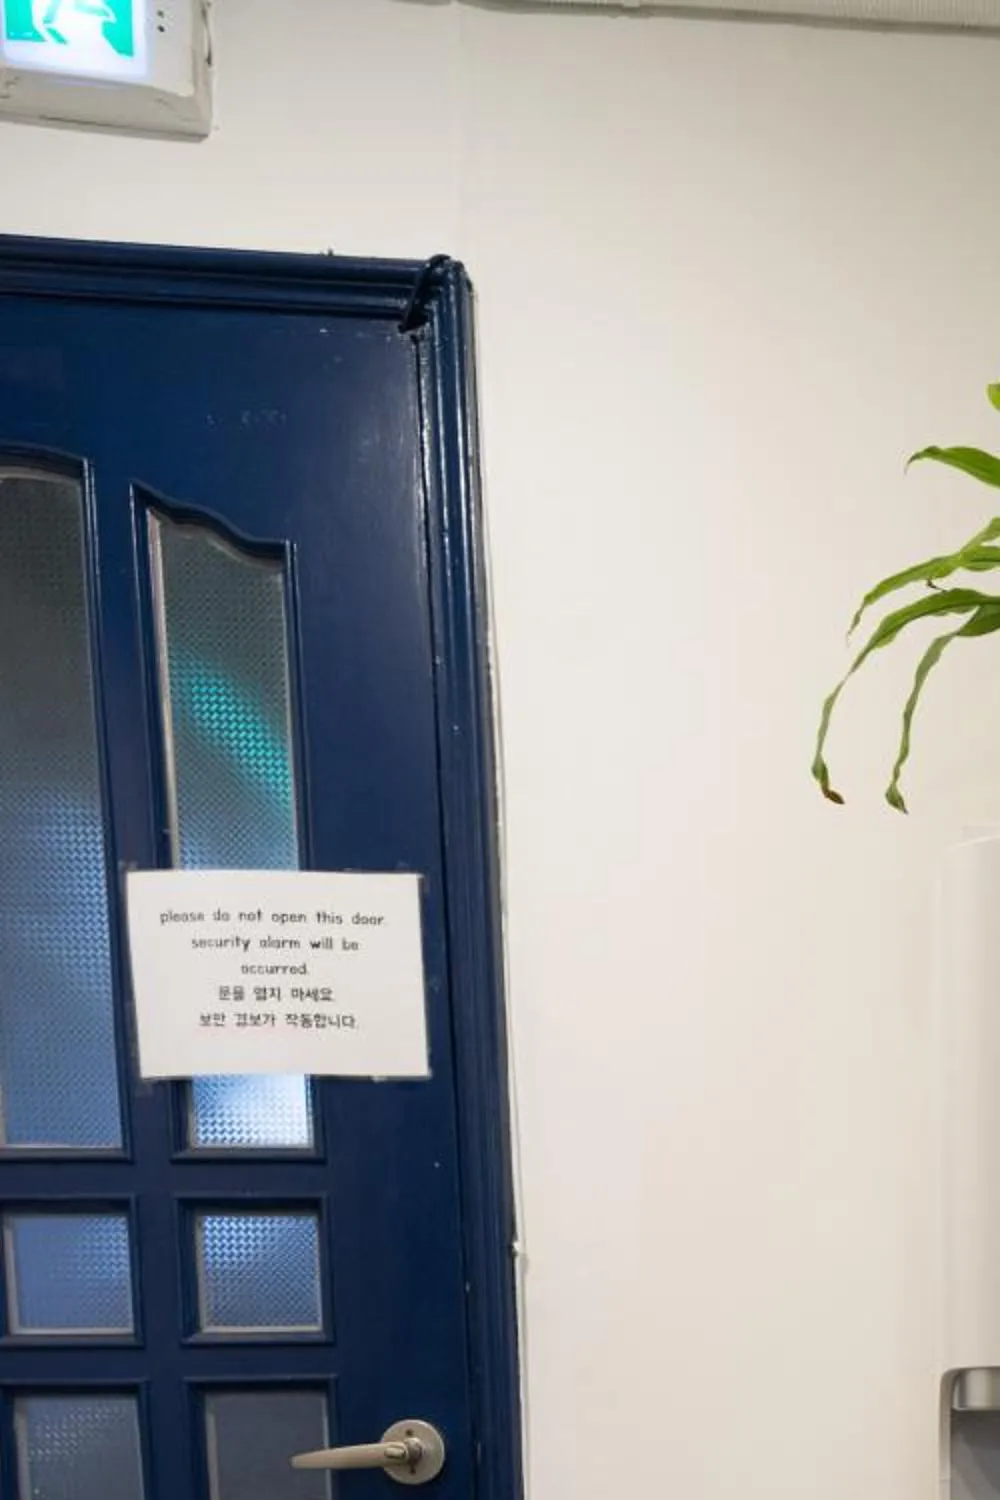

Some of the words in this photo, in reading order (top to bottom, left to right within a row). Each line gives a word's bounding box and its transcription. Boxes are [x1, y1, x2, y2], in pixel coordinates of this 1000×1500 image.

[159, 909, 205, 925] please
[213, 908, 231, 922] do
[238, 908, 262, 922] not
[271, 912, 307, 925] open
[316, 911, 343, 925] this
[191, 935, 251, 952] security
[259, 935, 301, 949] alarm
[309, 936, 334, 950] will
[341, 937, 360, 951] be
[218, 985, 245, 1001] 문을
[252, 985, 281, 1002] 열지
[199, 1011, 226, 1026] 보안
